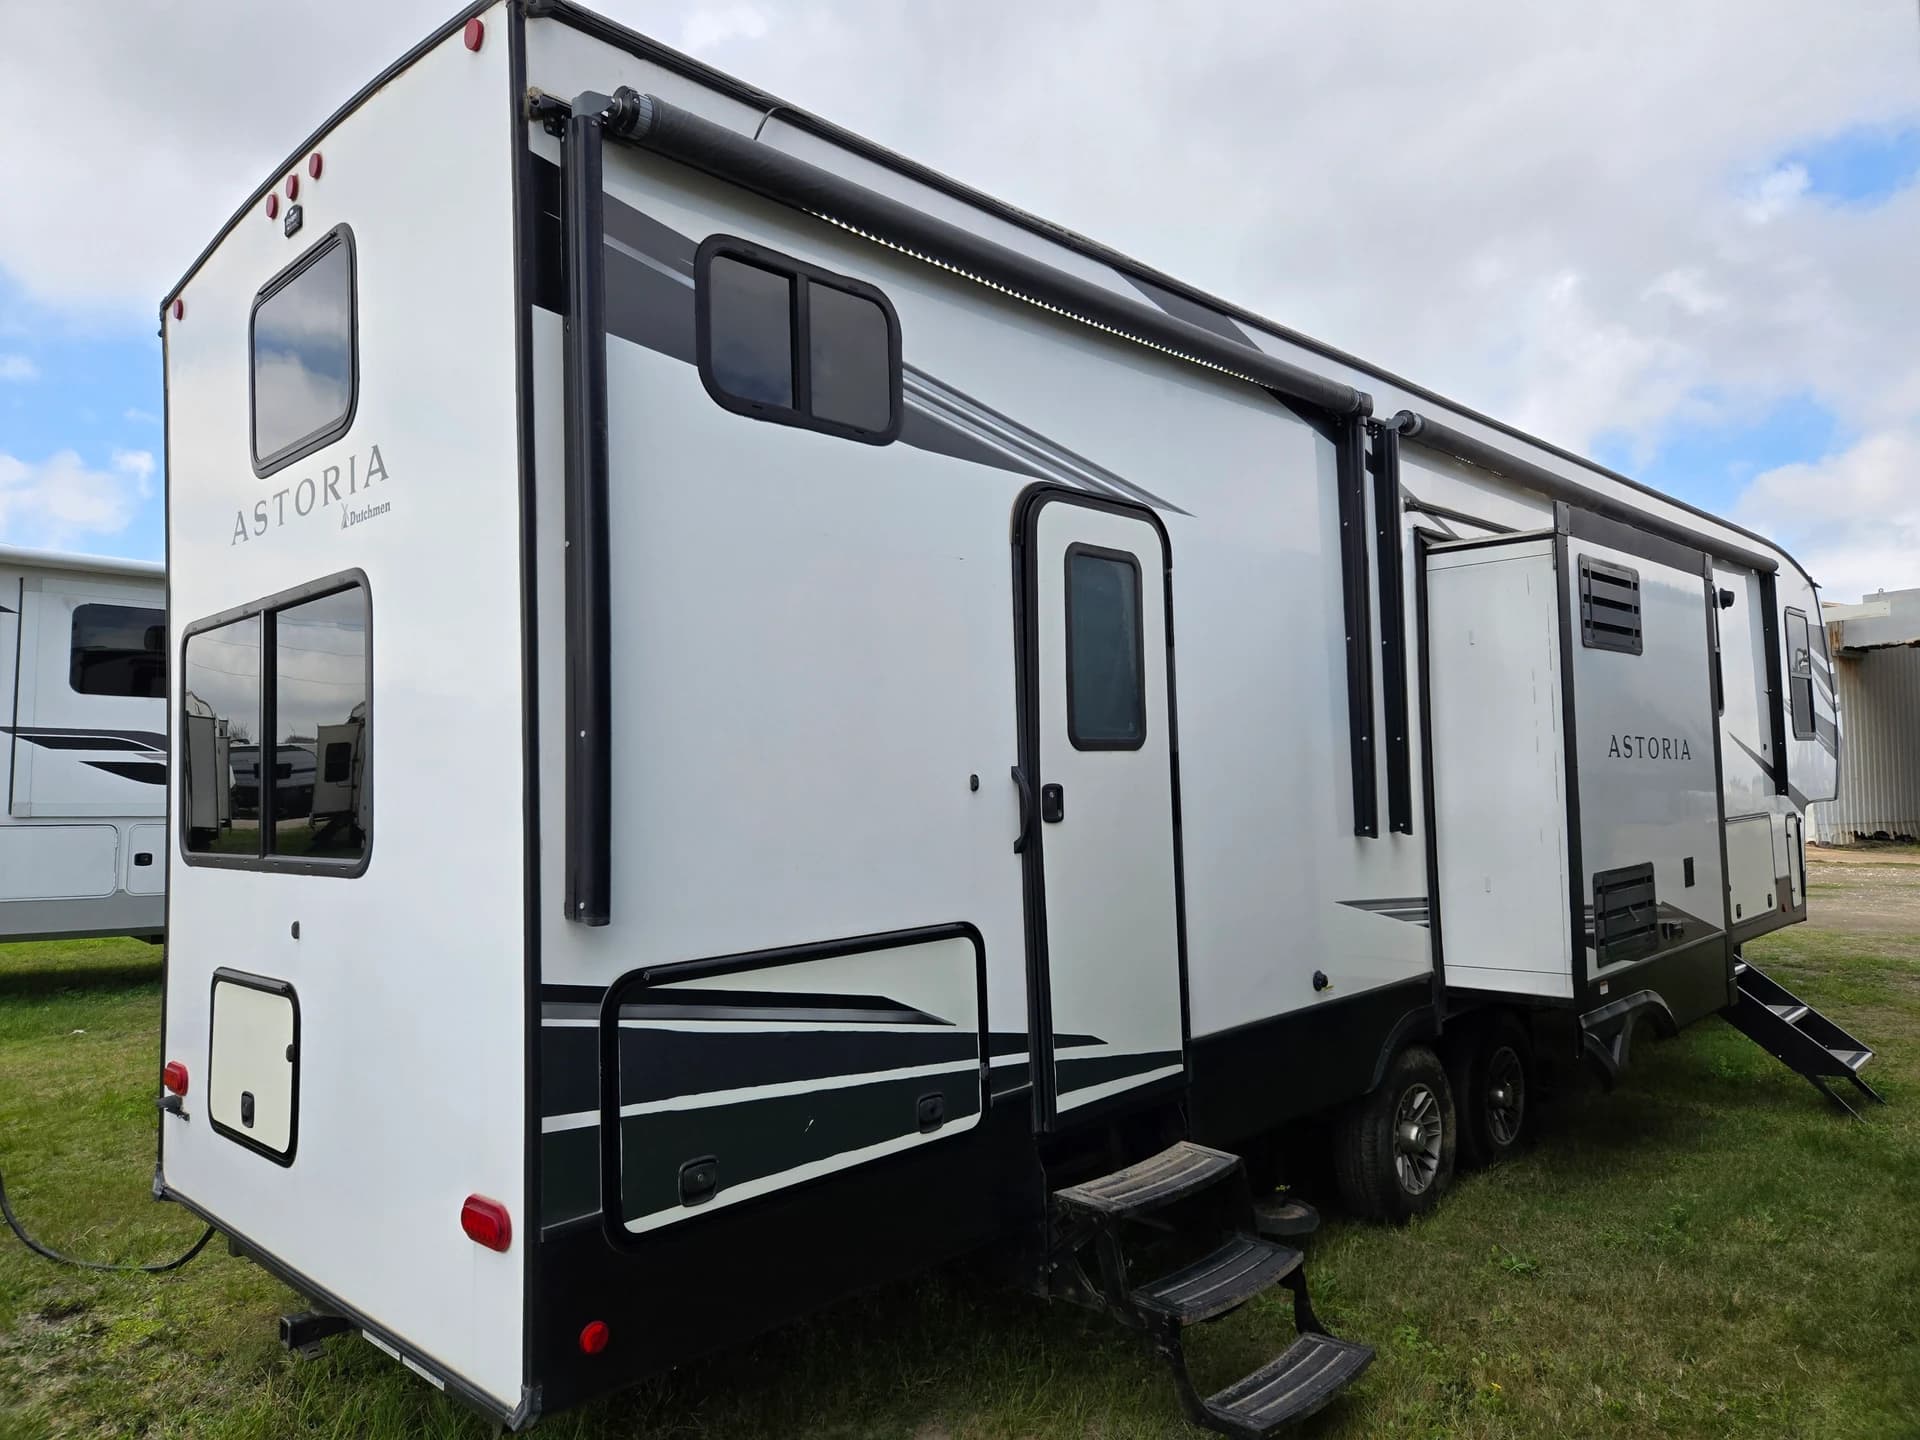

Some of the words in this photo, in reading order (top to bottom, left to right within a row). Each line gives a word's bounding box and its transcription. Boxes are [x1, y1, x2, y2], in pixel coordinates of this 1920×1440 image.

[231, 444, 390, 546] ASTORIA
[350, 501, 391, 526] Dutchmen
[1608, 734, 1691, 760] ASTORIA
